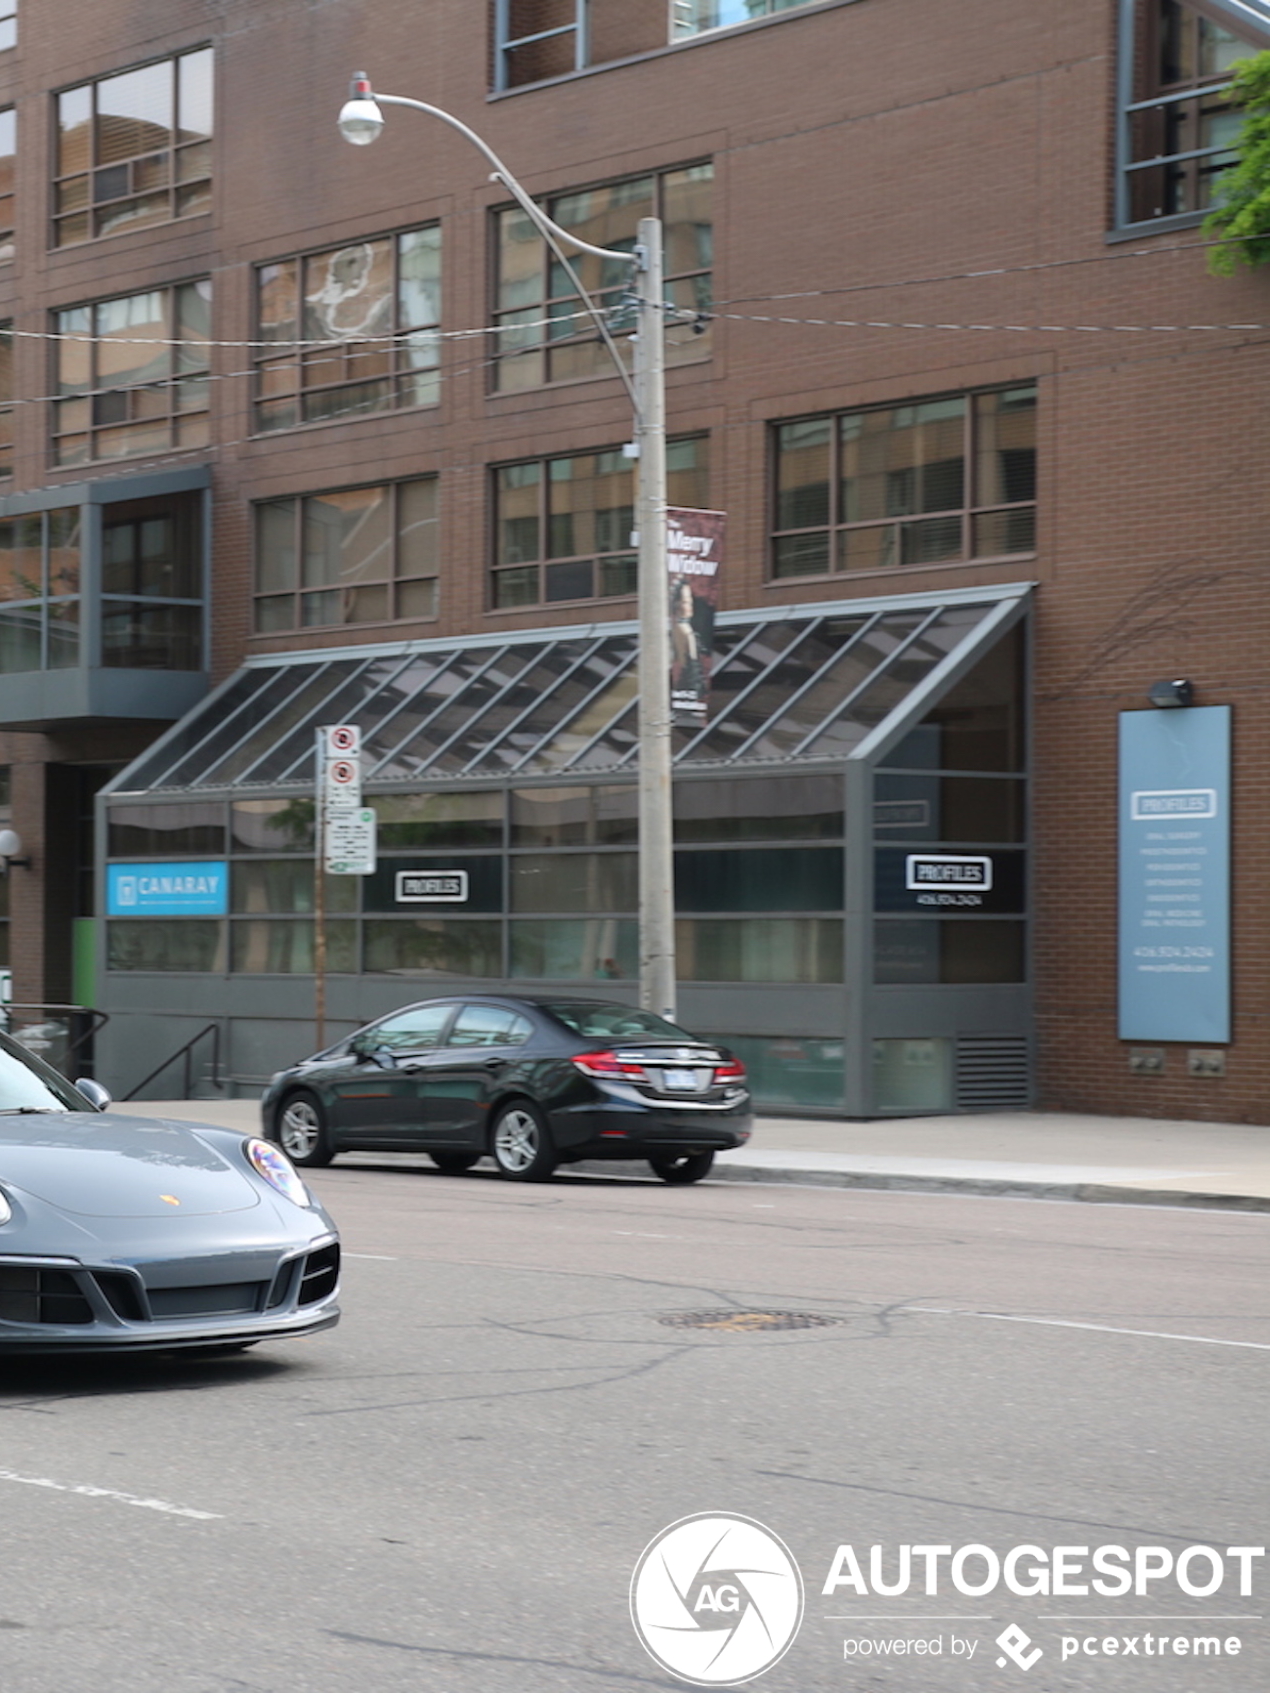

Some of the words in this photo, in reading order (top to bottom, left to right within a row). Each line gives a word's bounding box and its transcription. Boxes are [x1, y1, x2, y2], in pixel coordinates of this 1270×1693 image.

[1141, 797, 1207, 812] PROFILES
[917, 864, 983, 881] PROFILES
[138, 877, 219, 895] CANARAY
[404, 878, 460, 894] PROFILES
